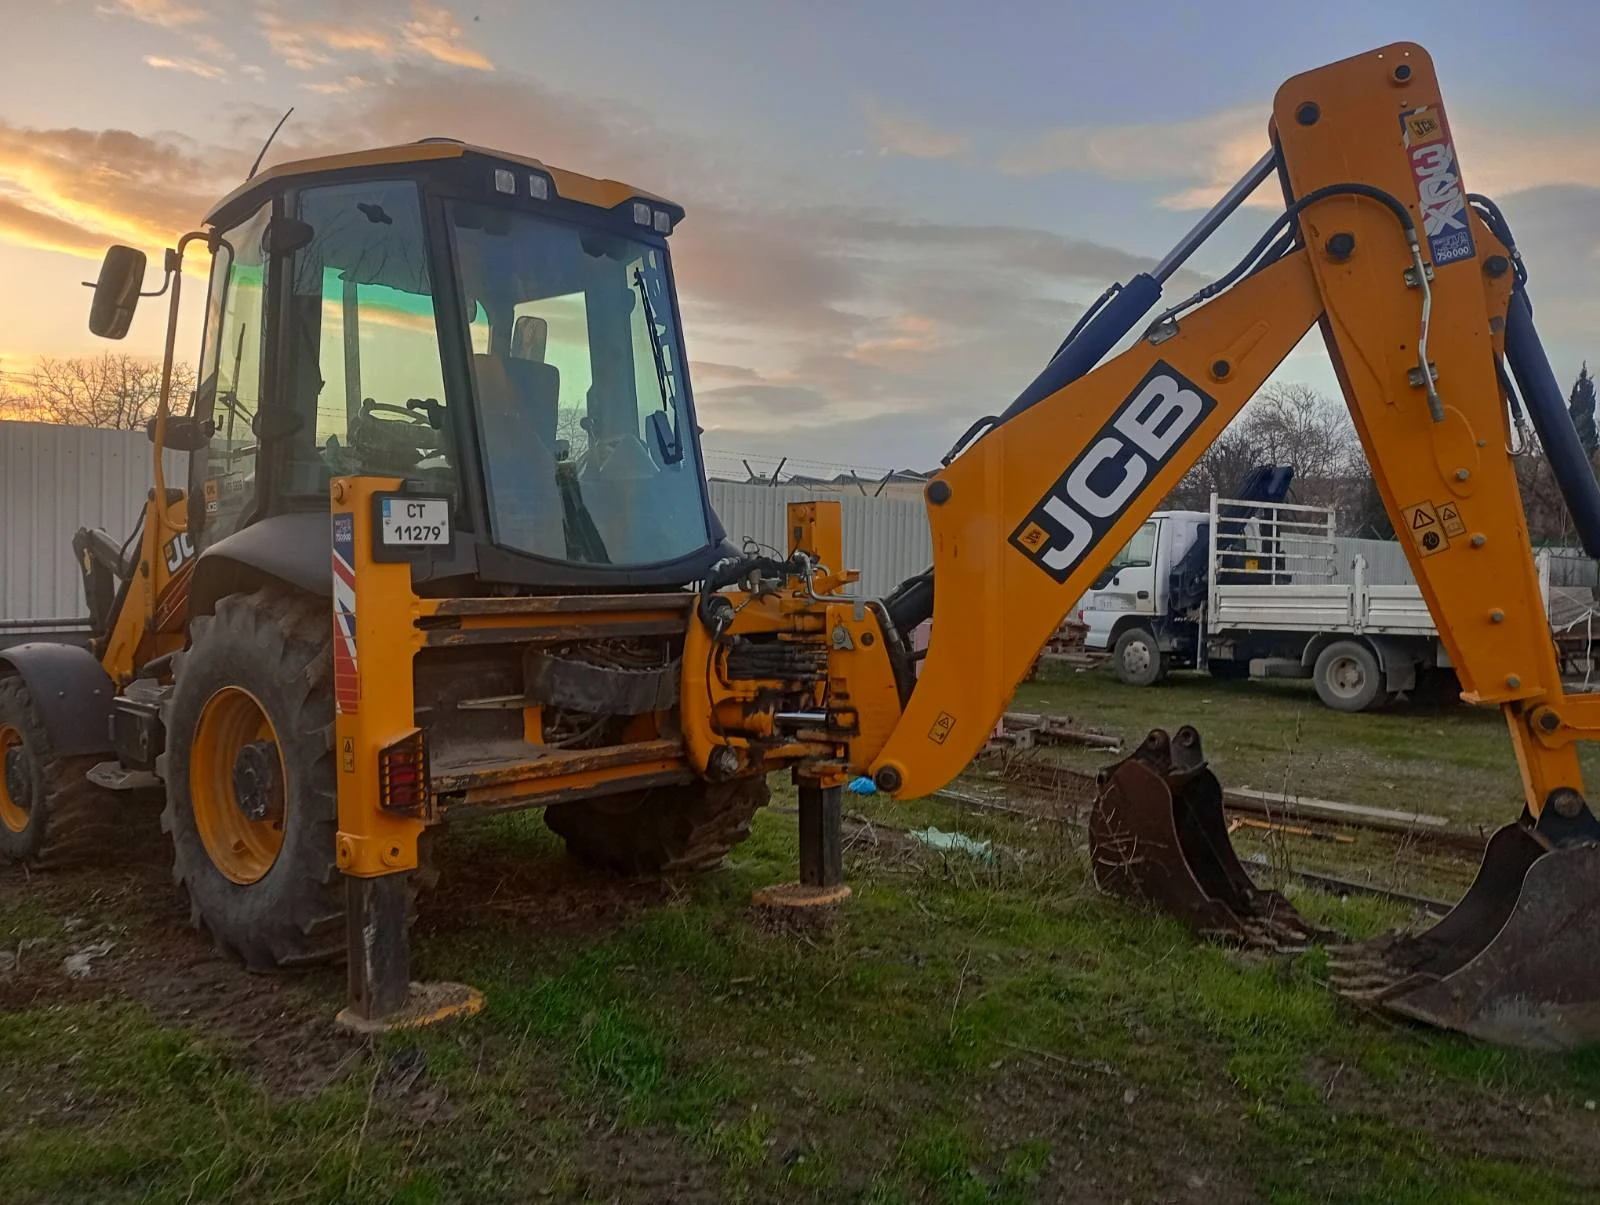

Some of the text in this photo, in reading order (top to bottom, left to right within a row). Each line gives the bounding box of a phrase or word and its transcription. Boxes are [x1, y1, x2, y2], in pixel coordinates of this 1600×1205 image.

[1412, 143, 1467, 237] 3CX
[1041, 374, 1203, 570] JCB
[394, 525, 441, 541] 11279
[407, 503, 426, 519] CT
